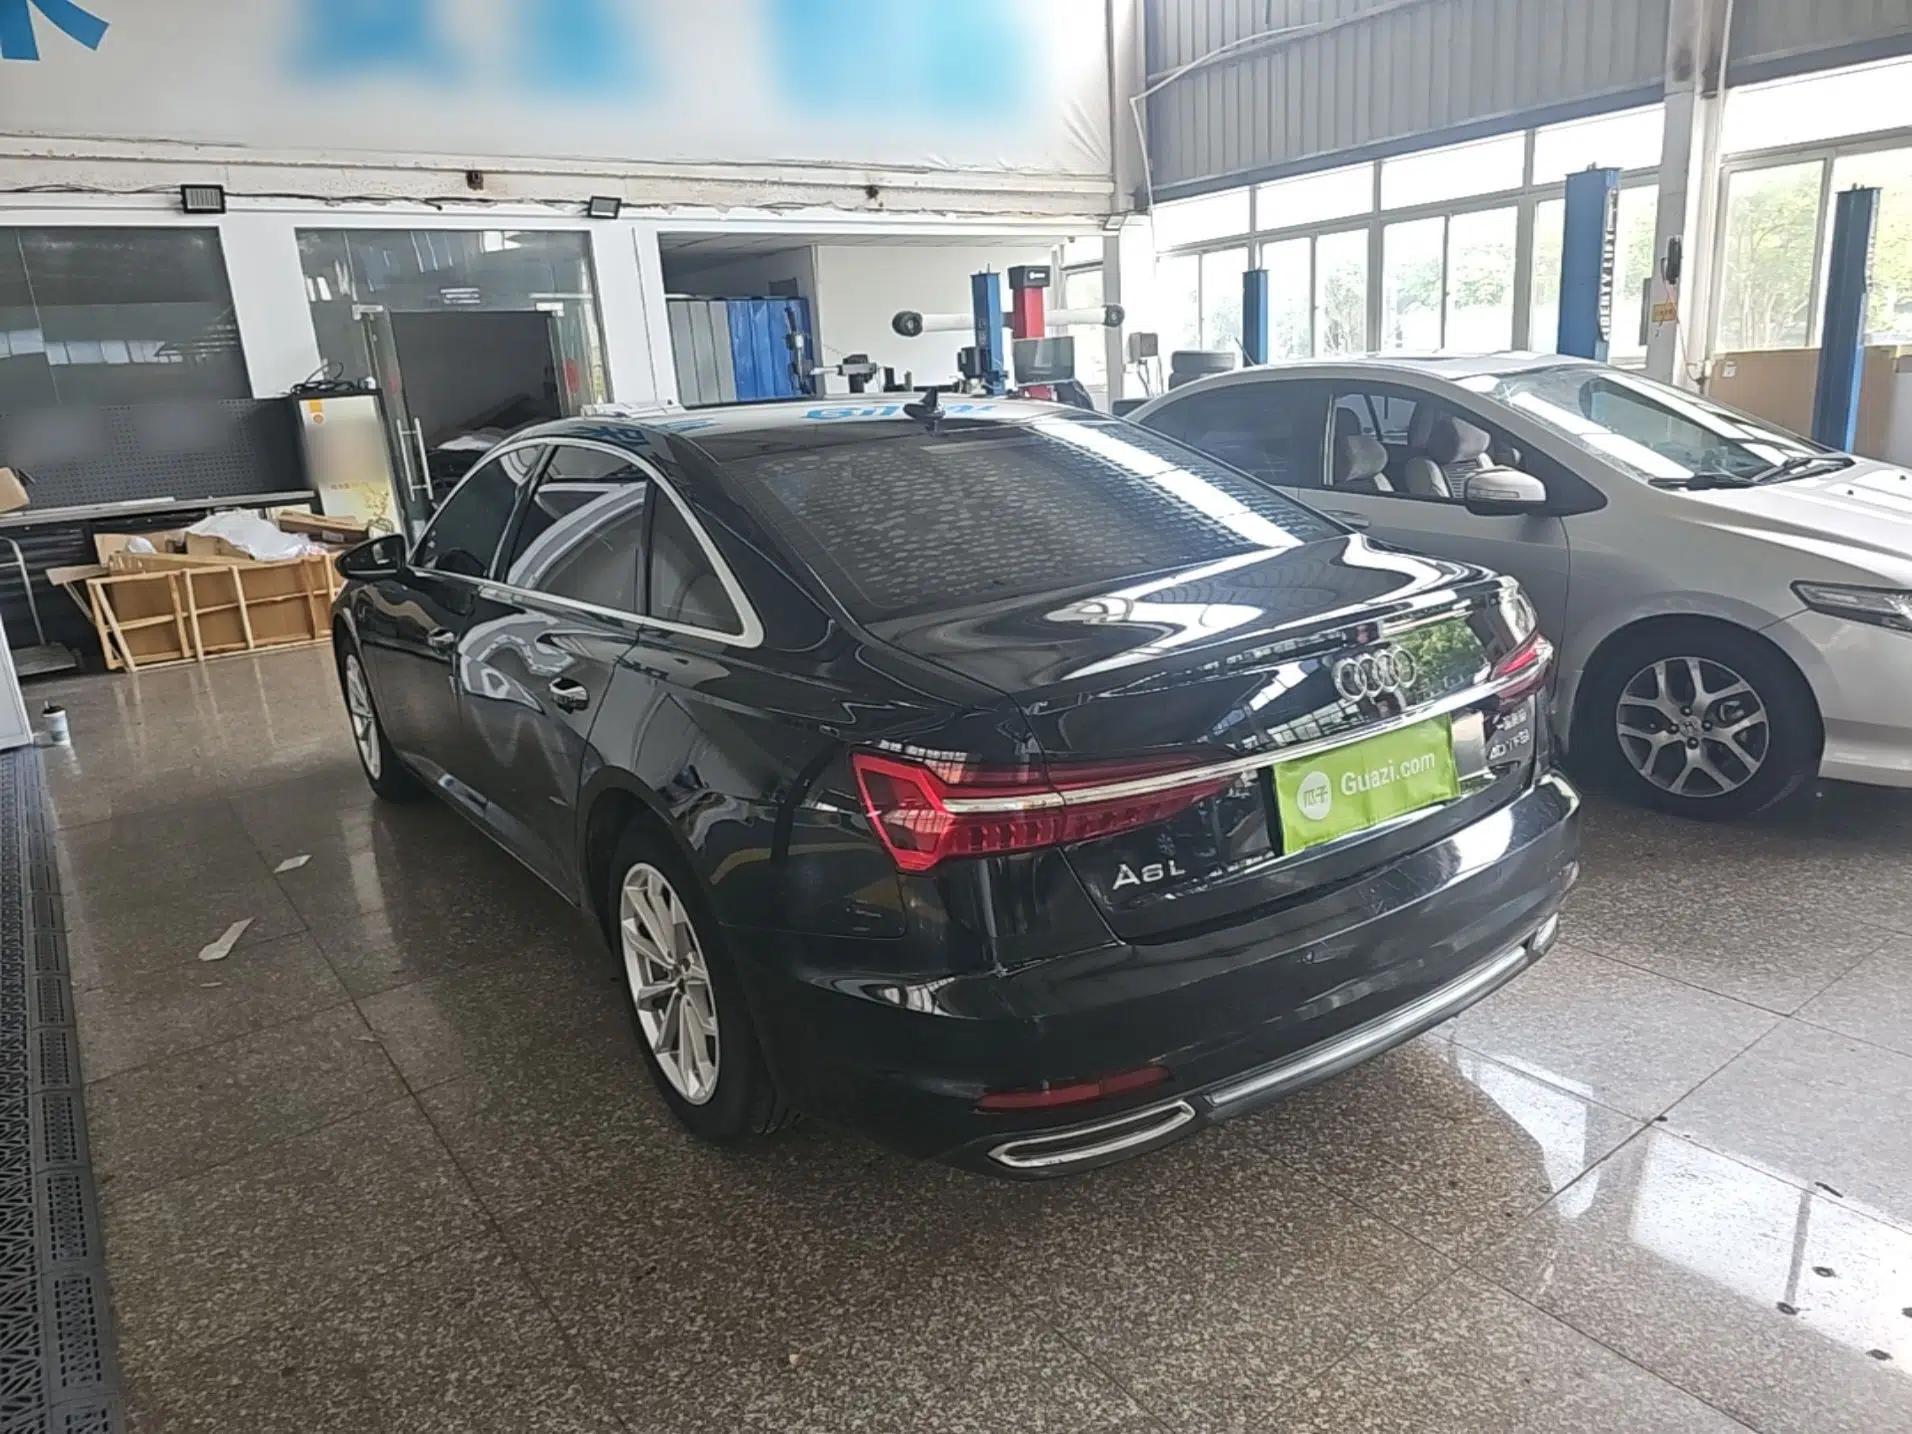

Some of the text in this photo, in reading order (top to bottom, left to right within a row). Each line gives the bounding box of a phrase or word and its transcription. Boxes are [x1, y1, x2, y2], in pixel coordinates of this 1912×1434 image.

[1340, 753, 1436, 796] Guazi.com
[1303, 784, 1329, 808] 瓜子
[1112, 860, 1186, 890] A6L
